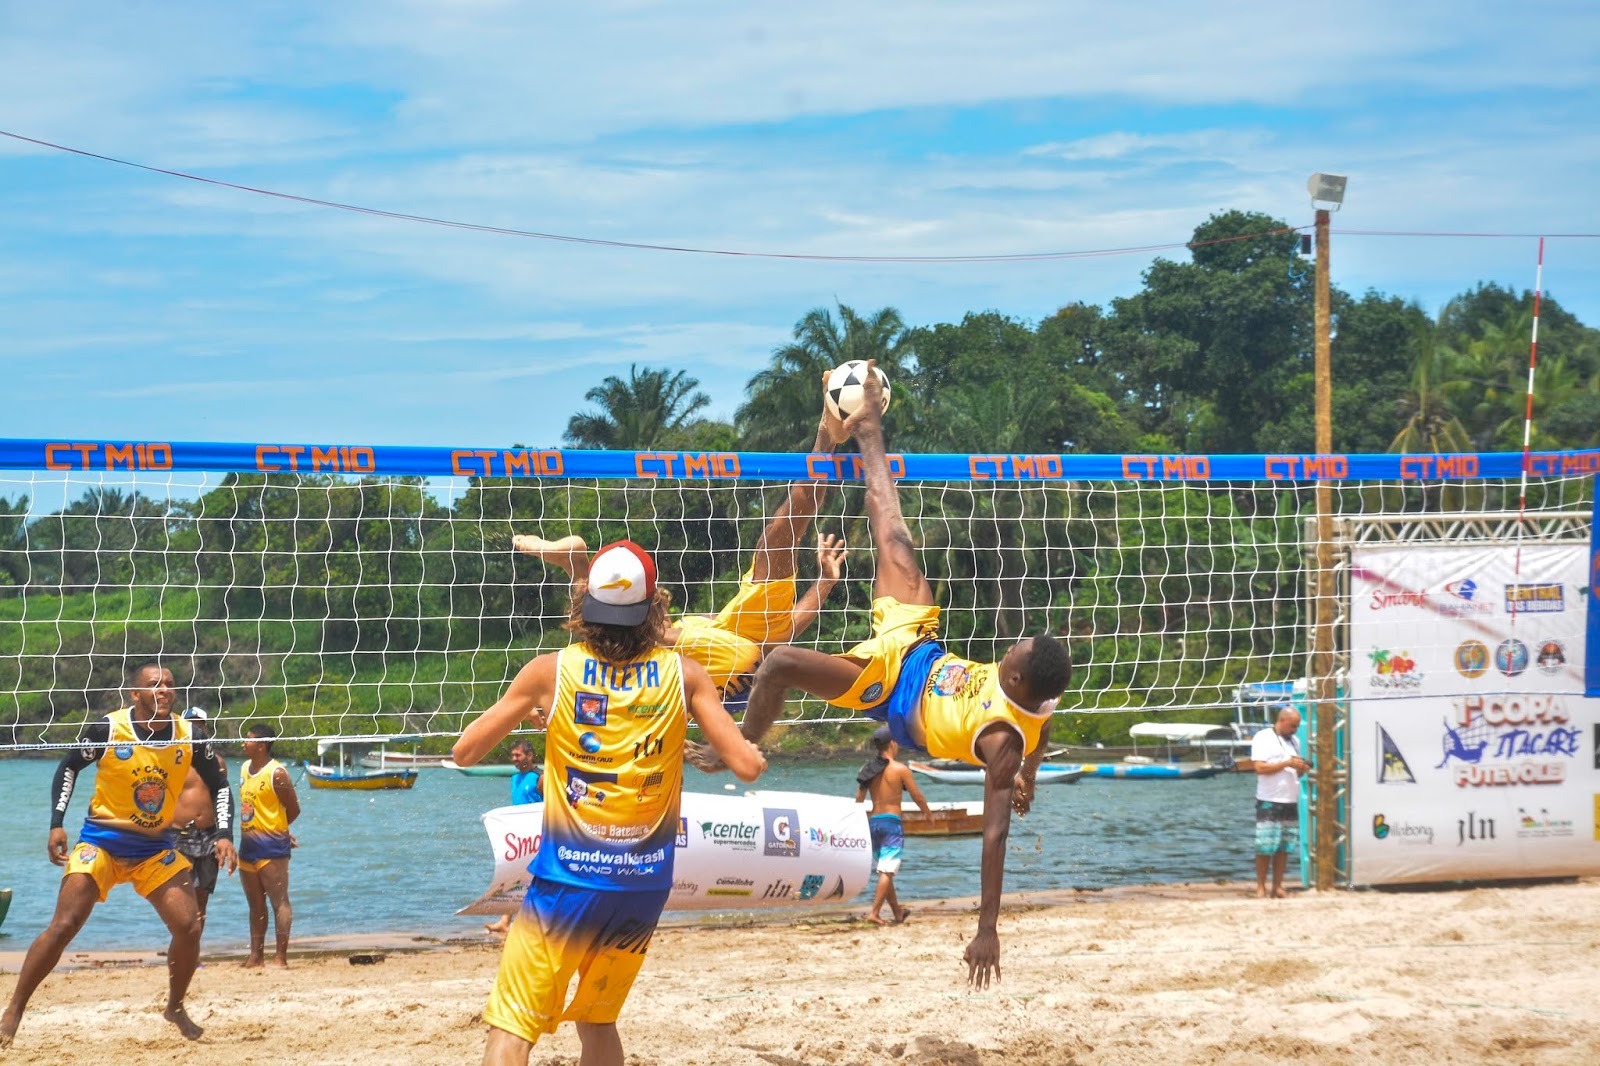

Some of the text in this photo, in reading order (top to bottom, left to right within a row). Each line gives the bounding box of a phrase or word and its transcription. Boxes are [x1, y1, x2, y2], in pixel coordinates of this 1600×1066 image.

[44, 443, 173, 471] CT M10
[255, 445, 375, 473] CT M10
[450, 450, 565, 476] CT M10
[634, 453, 741, 478] CT M10
[806, 454, 852, 479] CT
[968, 456, 1063, 479] CT M10
[1121, 456, 1211, 479] CT M10
[1264, 456, 1349, 479] CT M10
[1399, 455, 1480, 479] CT M10
[583, 659, 660, 691] ATLETA
[175, 749, 183, 765] 2
[259, 781, 265, 791] 2
[713, 821, 761, 839] center
[568, 863, 612, 875] SAND
